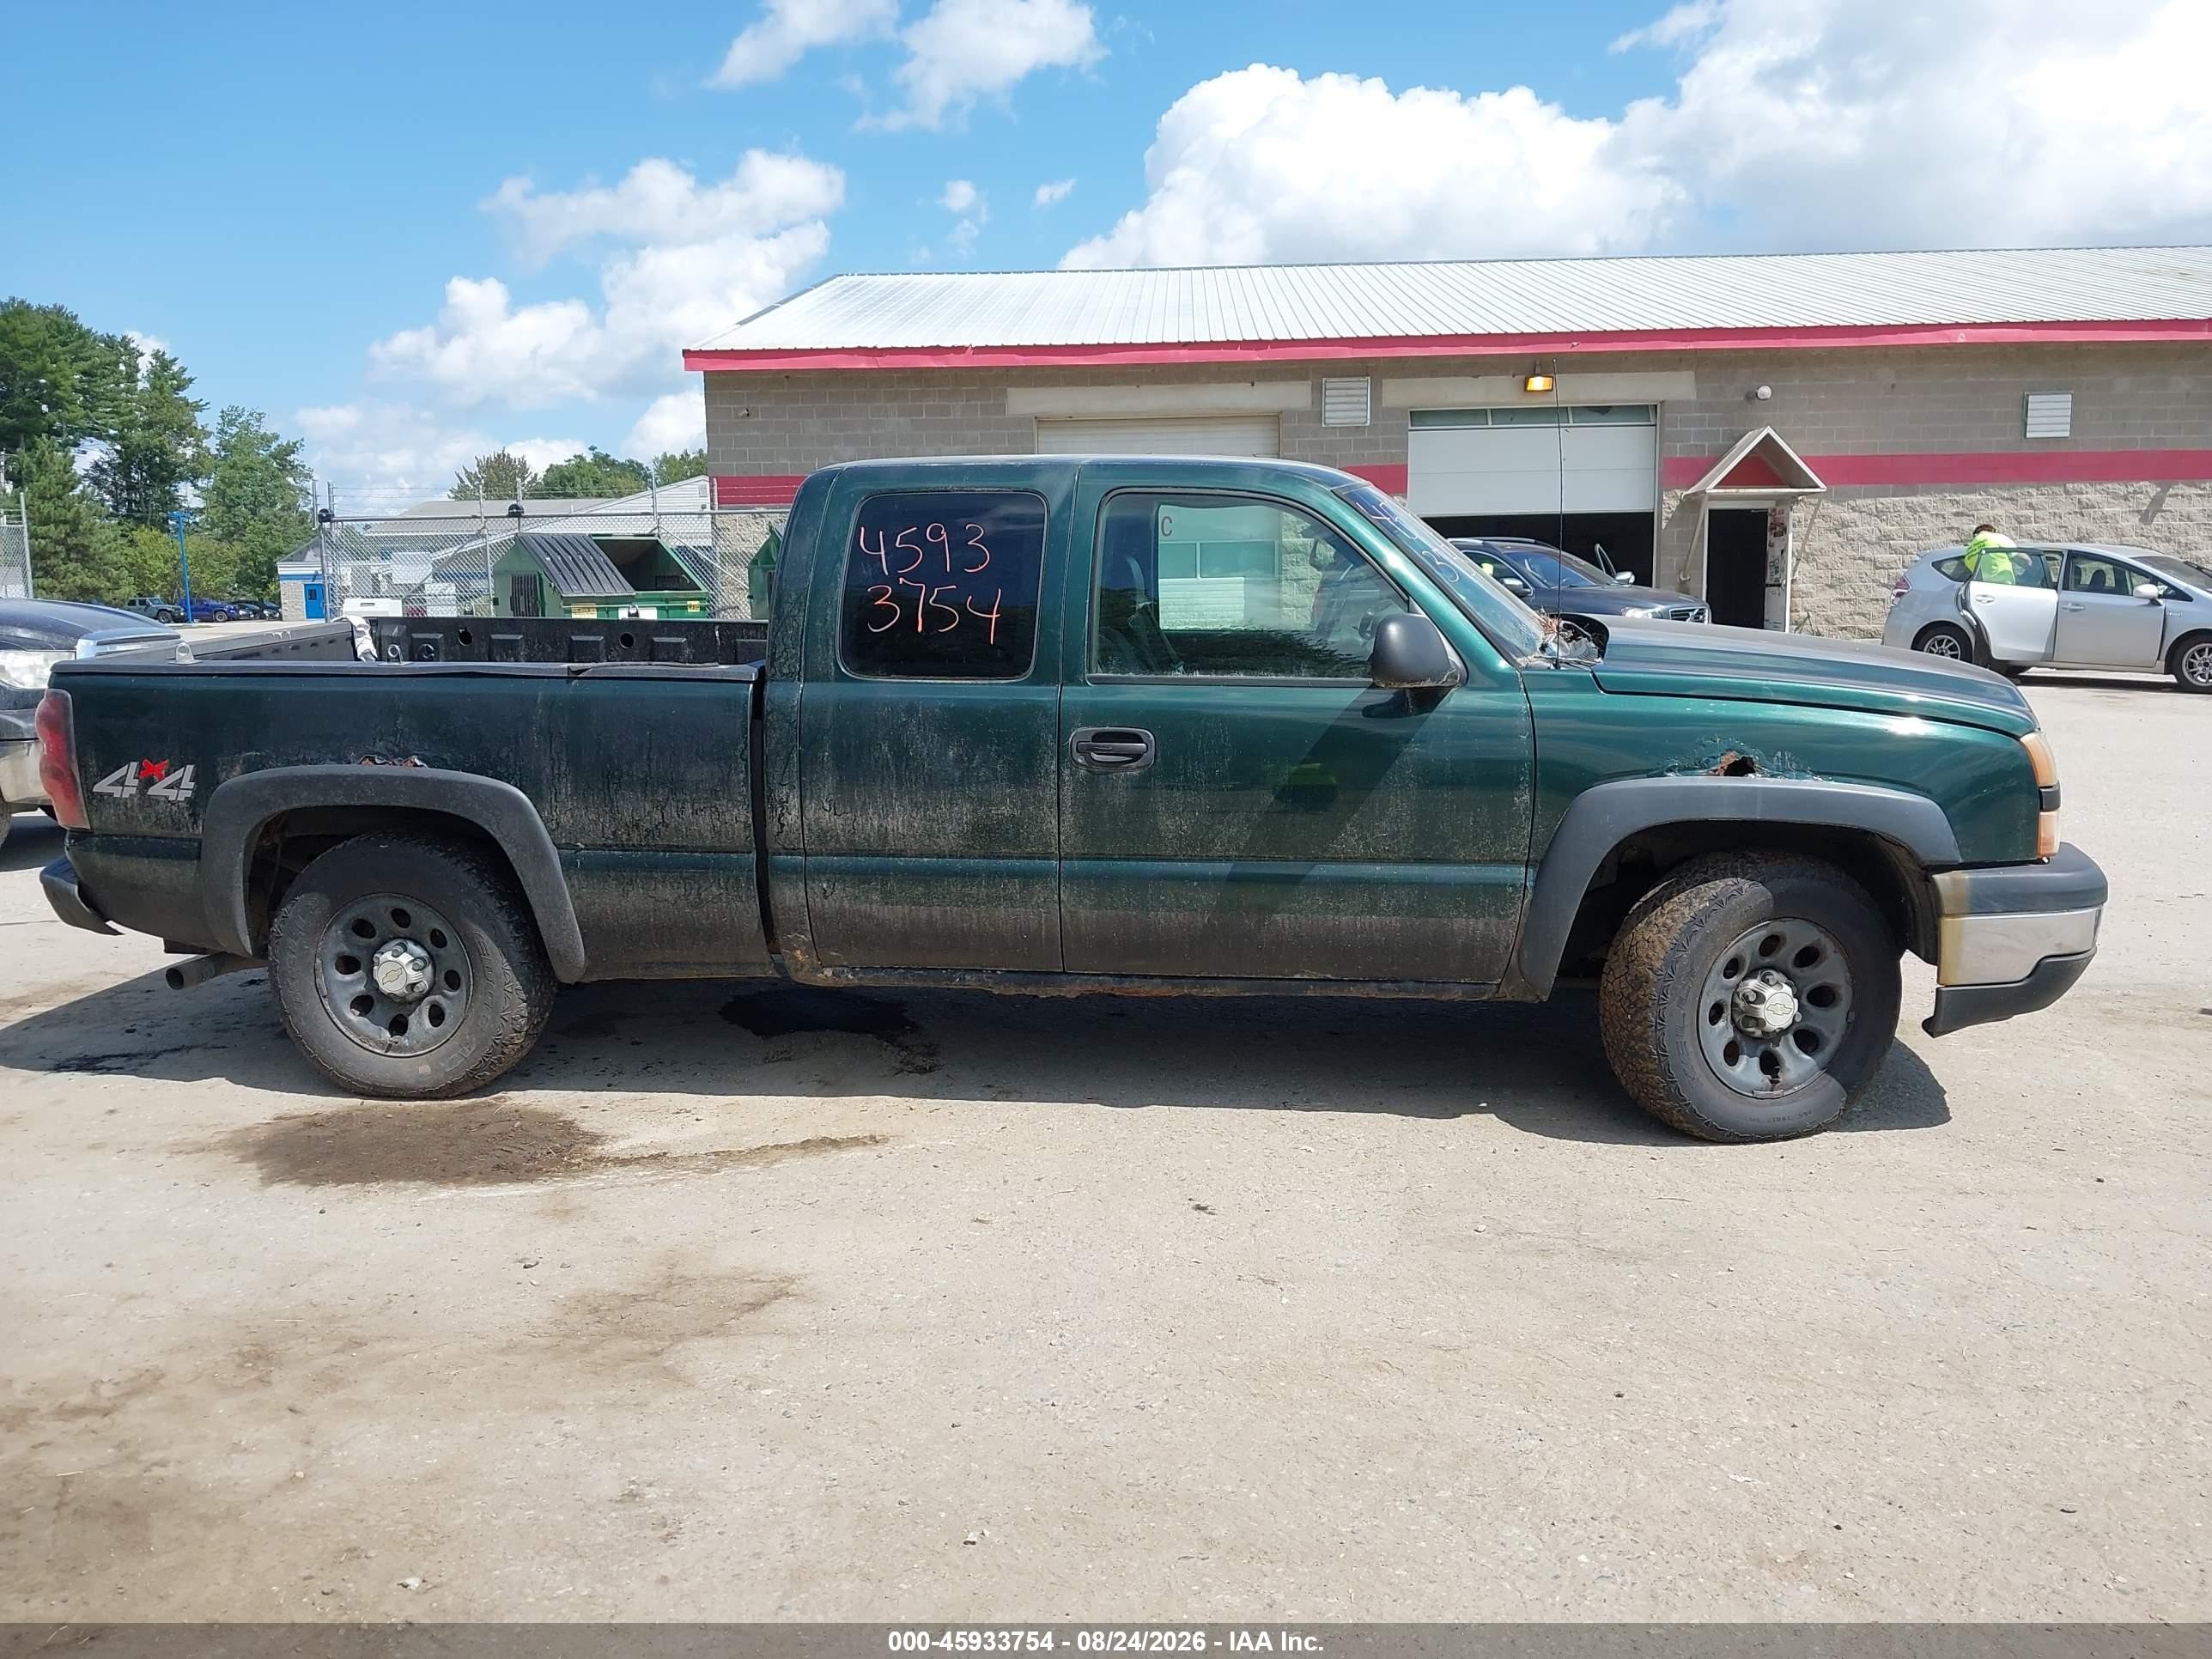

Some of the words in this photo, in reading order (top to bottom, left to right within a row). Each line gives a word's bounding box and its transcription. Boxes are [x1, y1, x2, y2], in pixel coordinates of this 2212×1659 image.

[860, 523, 990, 576] 4593
[1160, 515, 1173, 537] C
[867, 577, 1002, 645] 3754
